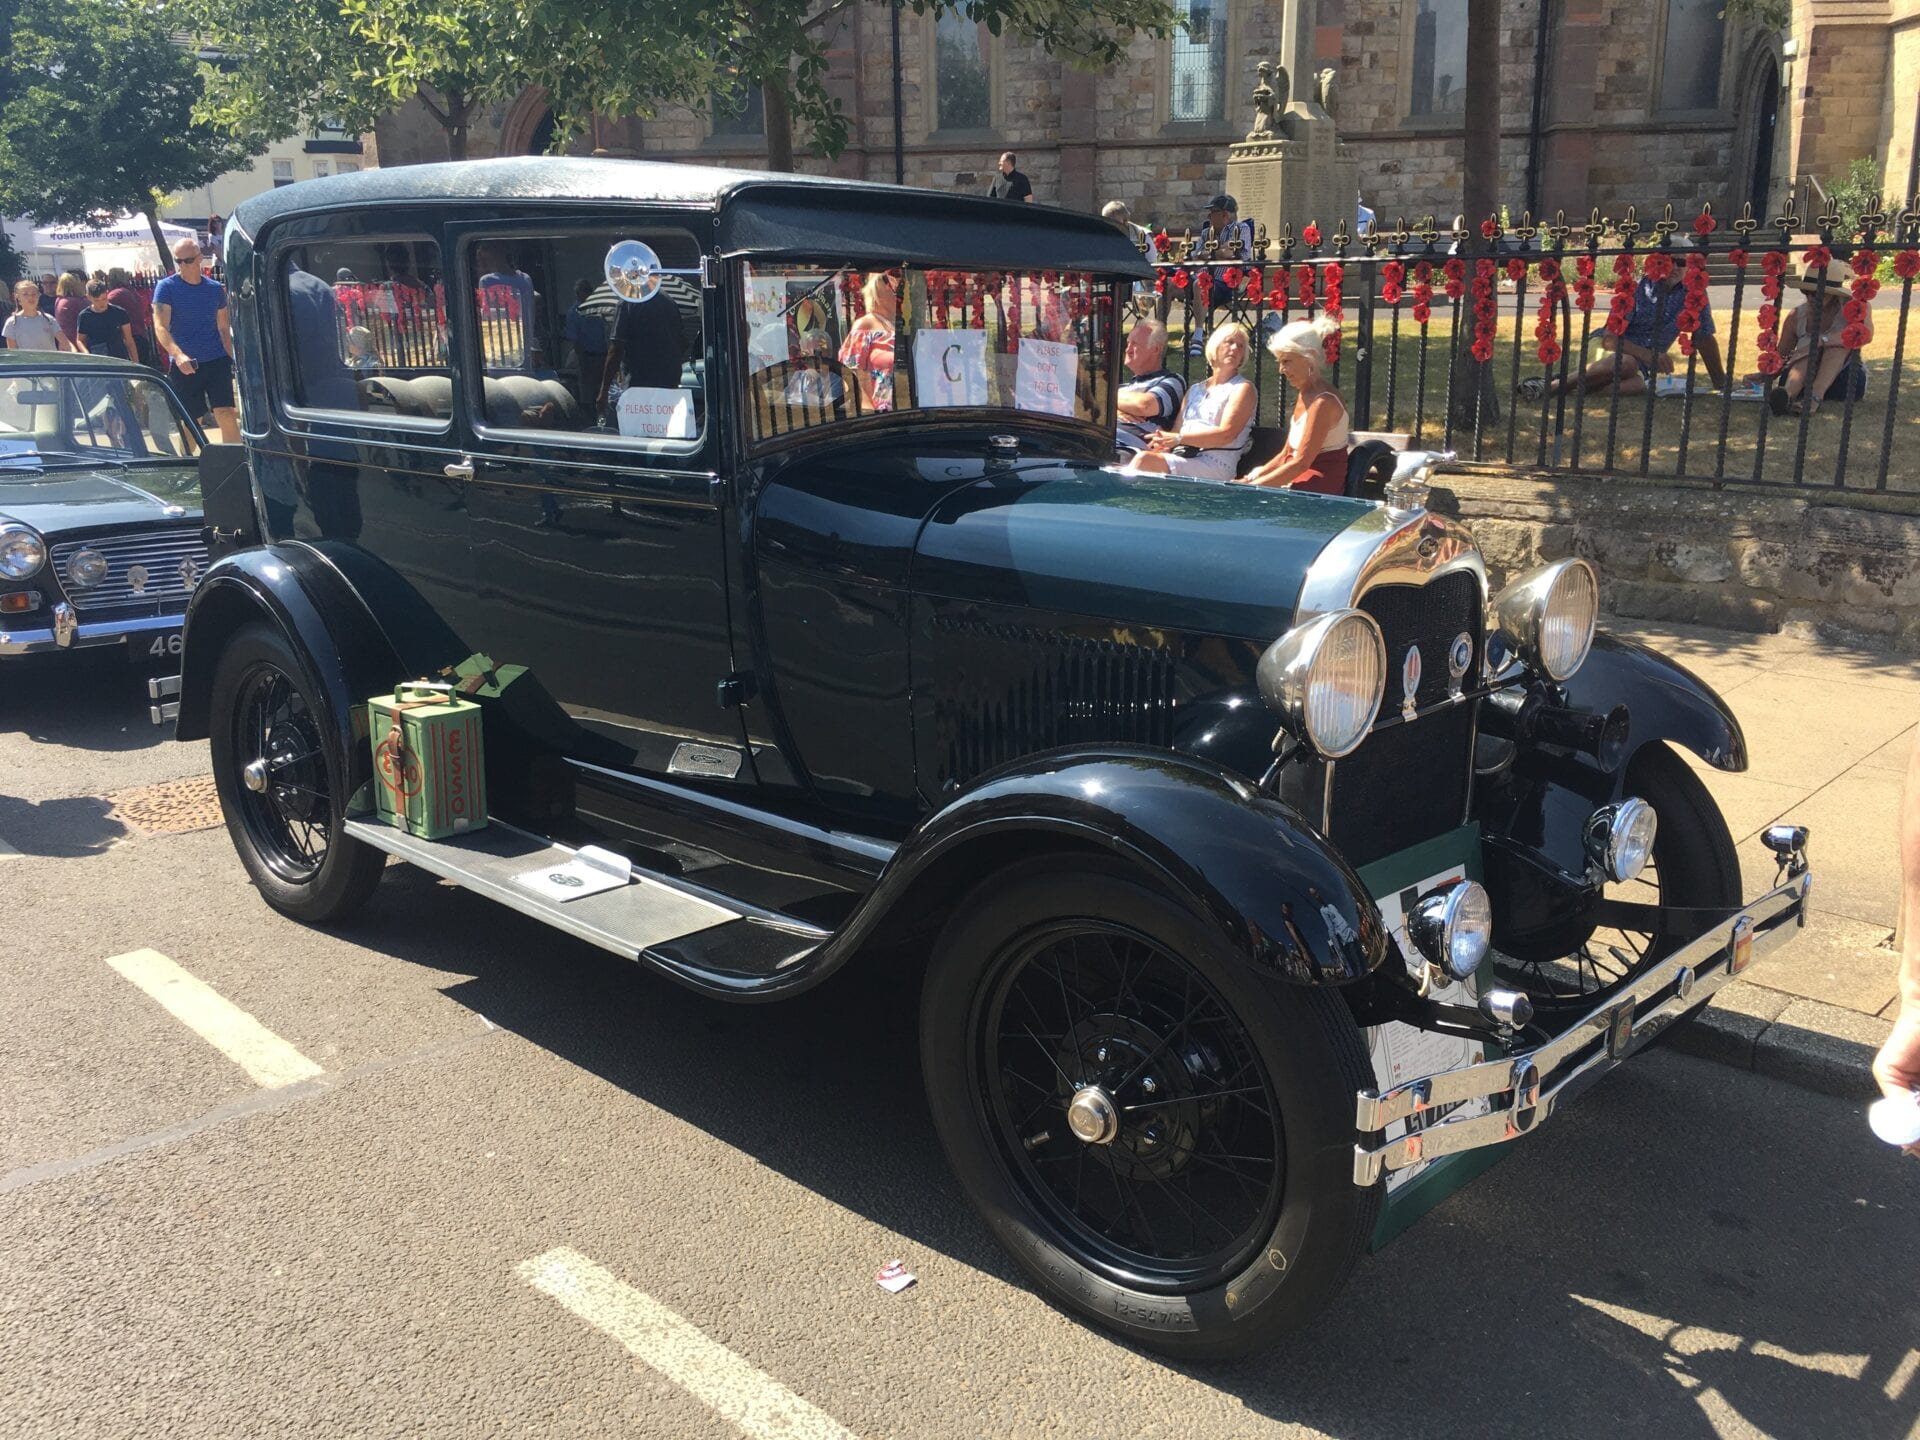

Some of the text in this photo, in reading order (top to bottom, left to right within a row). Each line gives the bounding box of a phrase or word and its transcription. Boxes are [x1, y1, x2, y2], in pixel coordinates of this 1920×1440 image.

[943, 344, 962, 382] C
[1034, 380, 1059, 393] TOCH
[625, 404, 654, 415] PLEASE
[642, 423, 668, 434] TOUCH
[149, 634, 182, 657] 46
[449, 728, 465, 814] ESSO
